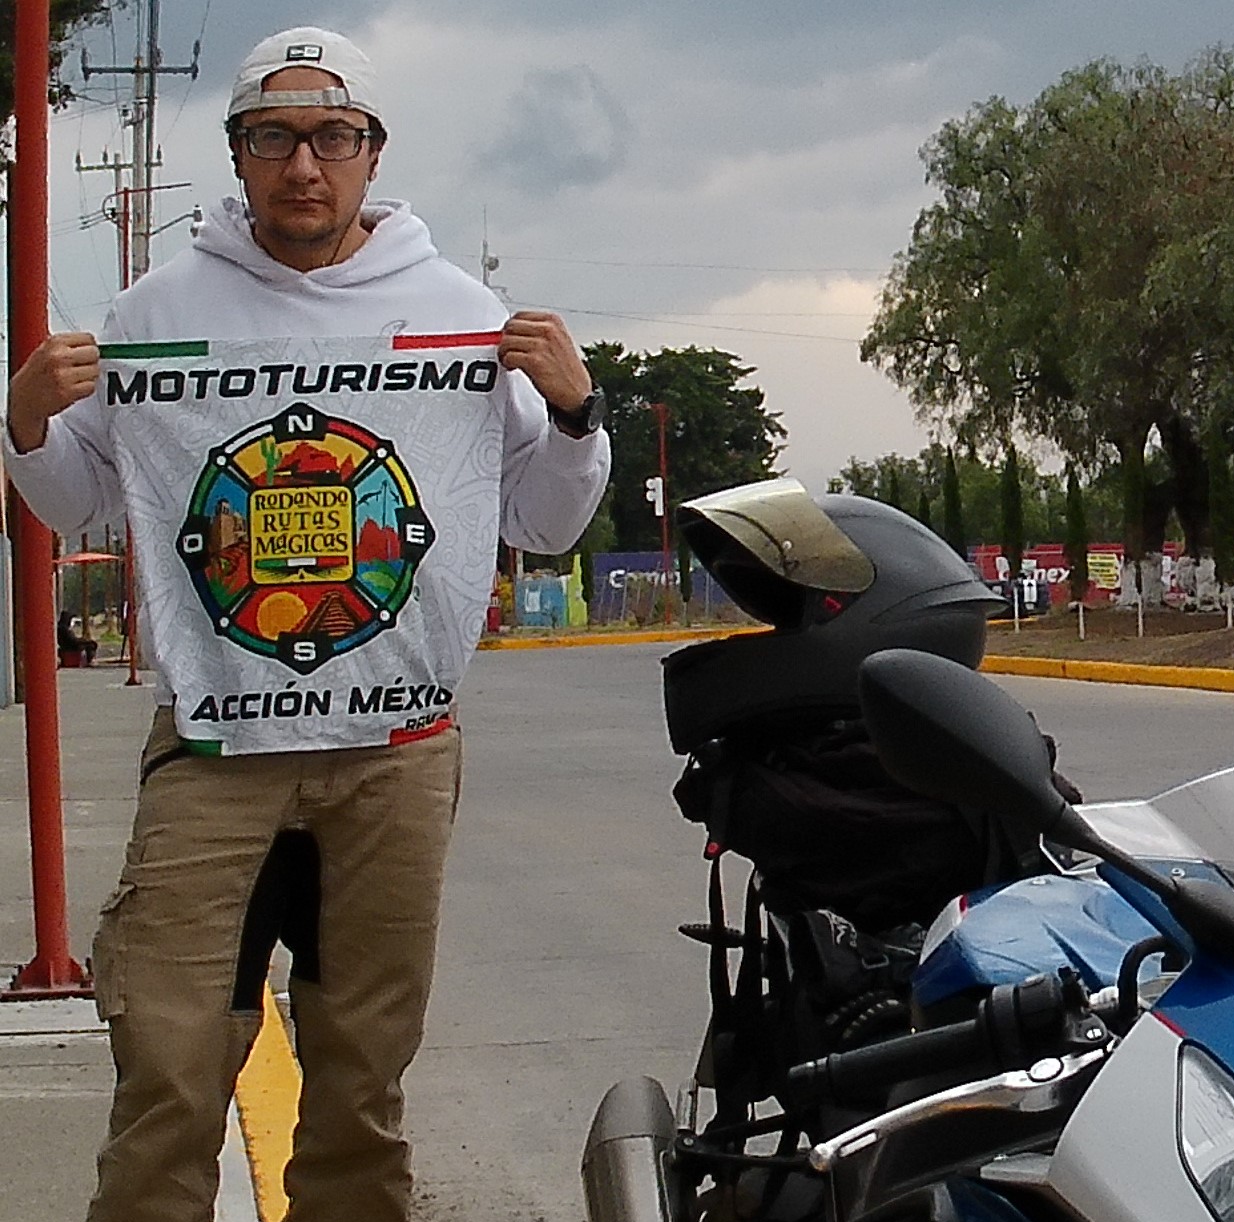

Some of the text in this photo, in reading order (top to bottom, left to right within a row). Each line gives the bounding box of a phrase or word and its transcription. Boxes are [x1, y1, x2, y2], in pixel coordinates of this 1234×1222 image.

[107, 361, 498, 406] MOTOTURISMO
[288, 414, 313, 432] N
[255, 489, 348, 511] RODANDO
[263, 510, 340, 533] RUTAS
[183, 534, 203, 553] O
[406, 524, 425, 544] E
[294, 642, 316, 661] S
[190, 681, 332, 722] ACCIÓN
